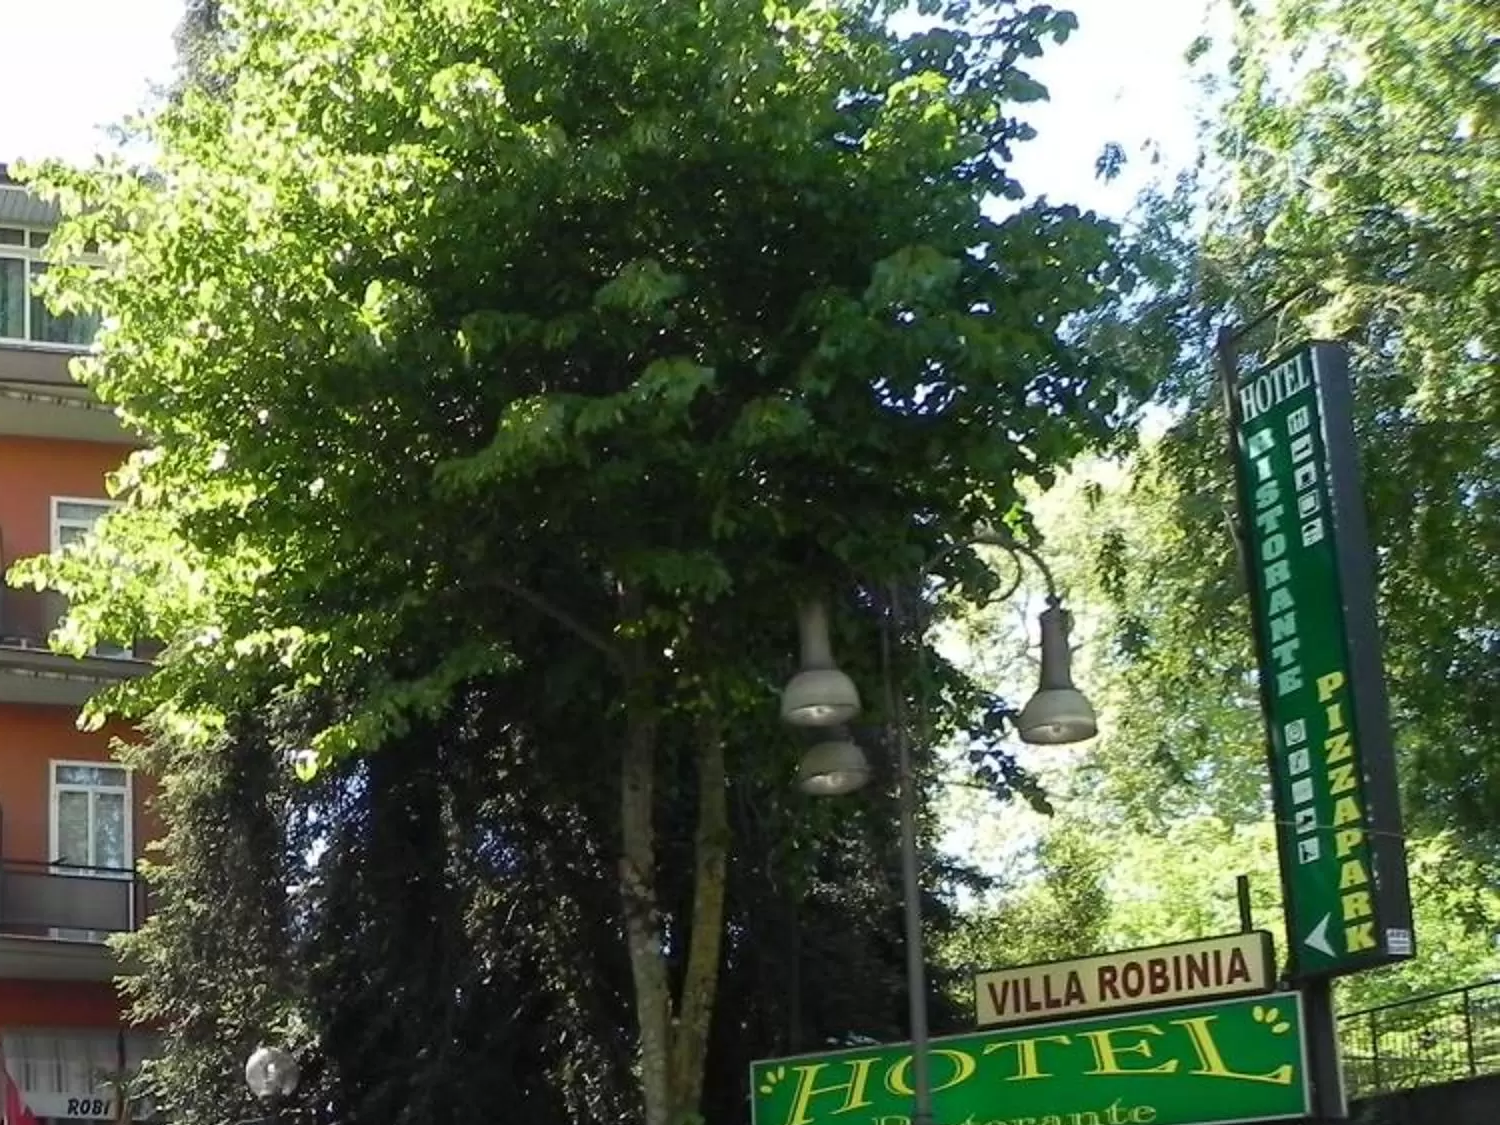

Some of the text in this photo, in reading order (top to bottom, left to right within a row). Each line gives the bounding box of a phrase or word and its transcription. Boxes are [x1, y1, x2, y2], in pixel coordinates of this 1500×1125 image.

[1239, 351, 1312, 425] HOTEL
[1247, 426, 1303, 698] RISTORANTE
[987, 946, 1253, 1017] VILLA ROBINIA
[67, 1098, 111, 1116] ROBI
